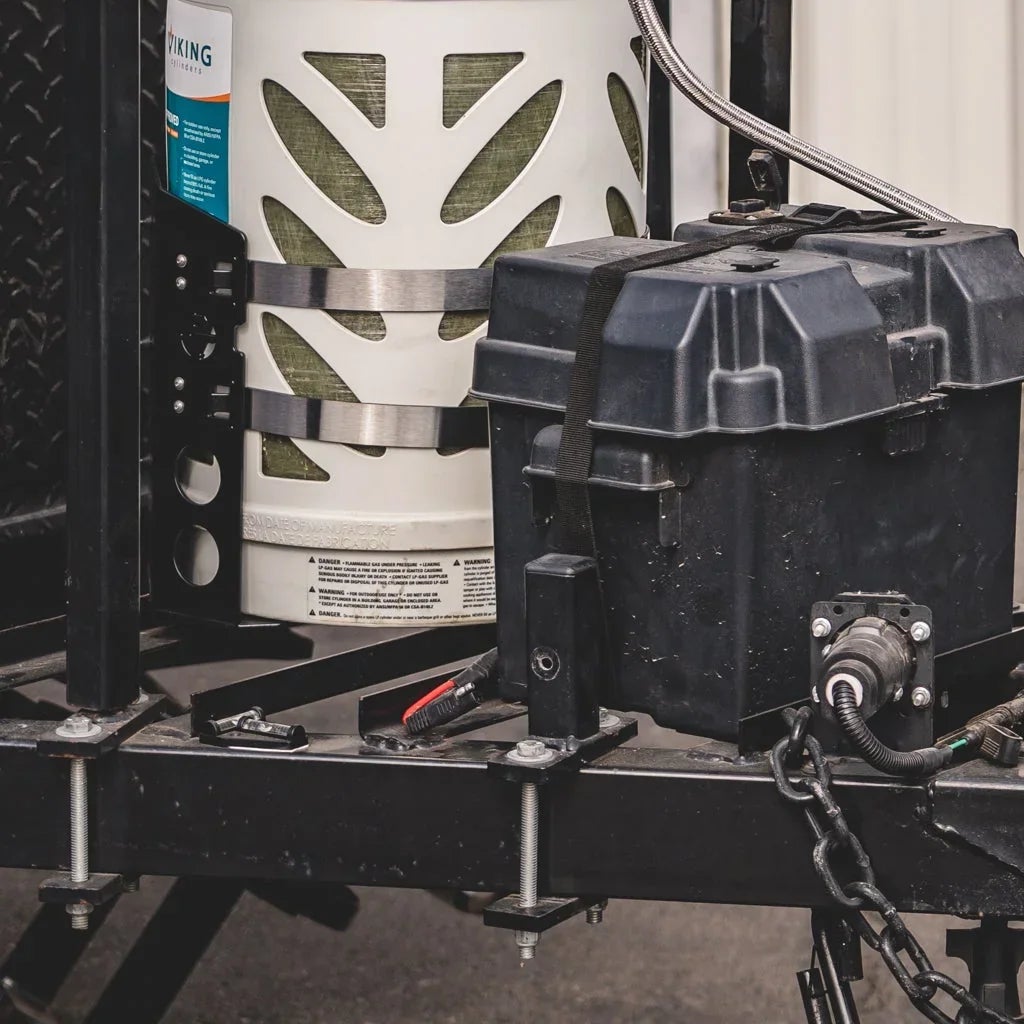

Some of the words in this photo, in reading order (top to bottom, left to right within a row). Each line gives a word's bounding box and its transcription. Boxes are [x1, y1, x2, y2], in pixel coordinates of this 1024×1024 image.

[168, 31, 212, 67] VIKING
[171, 58, 202, 75] cylinders
[312, 533, 390, 550] FABRICATION
